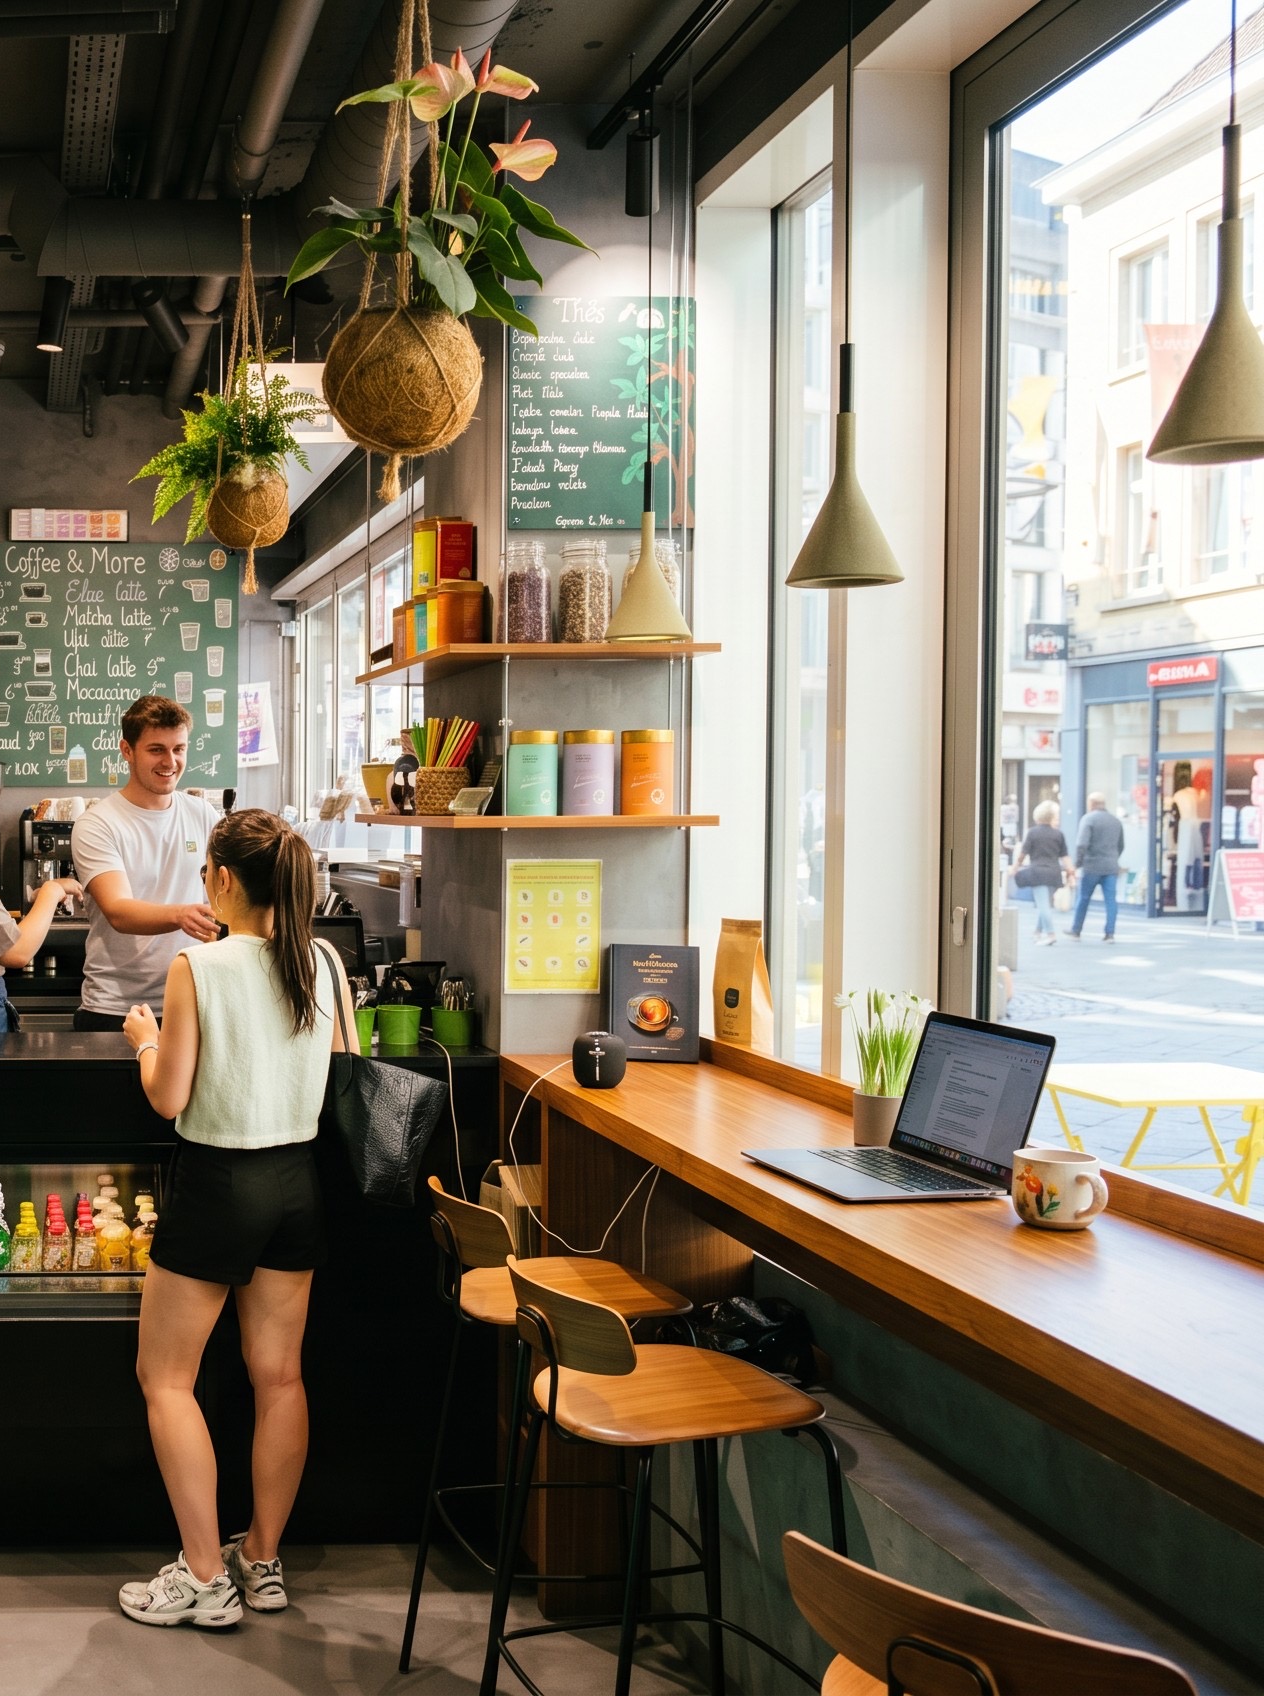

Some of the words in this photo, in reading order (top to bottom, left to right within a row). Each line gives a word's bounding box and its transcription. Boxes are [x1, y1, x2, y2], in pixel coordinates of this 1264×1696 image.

[5, 546, 61, 579] Coffee
[67, 549, 84, 573] &
[89, 546, 146, 574] More
[63, 604, 114, 626] Matcha
[121, 606, 152, 626] latte
[64, 652, 98, 678] Chai
[106, 654, 137, 678] latte
